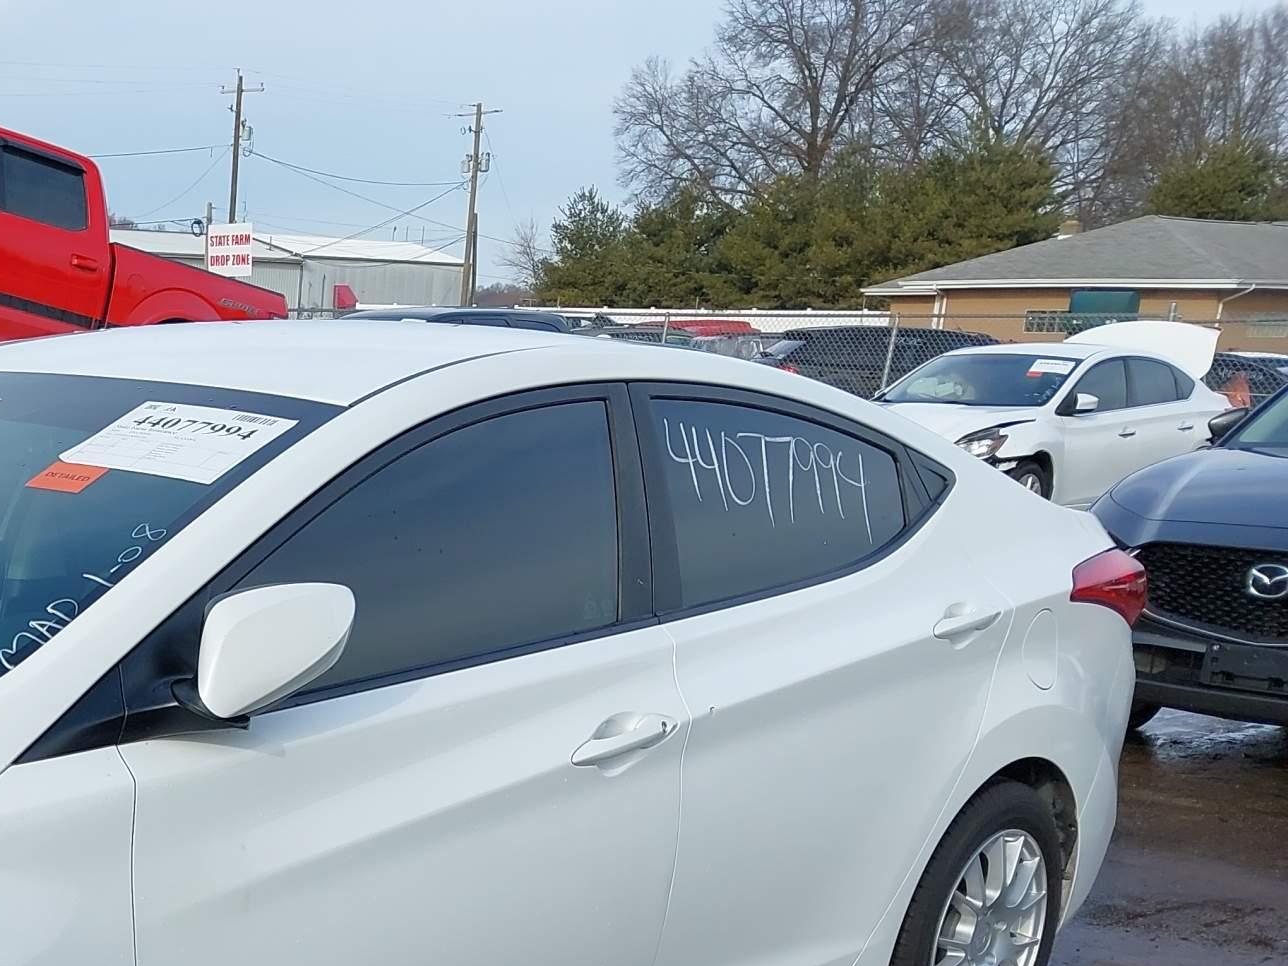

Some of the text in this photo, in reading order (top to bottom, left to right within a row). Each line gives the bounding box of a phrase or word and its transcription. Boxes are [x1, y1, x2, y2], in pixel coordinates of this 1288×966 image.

[209, 234, 251, 247] STATE FARM
[209, 254, 250, 267] DROP ZONE
[133, 415, 259, 440] 44077994
[663, 417, 873, 545] 44077994
